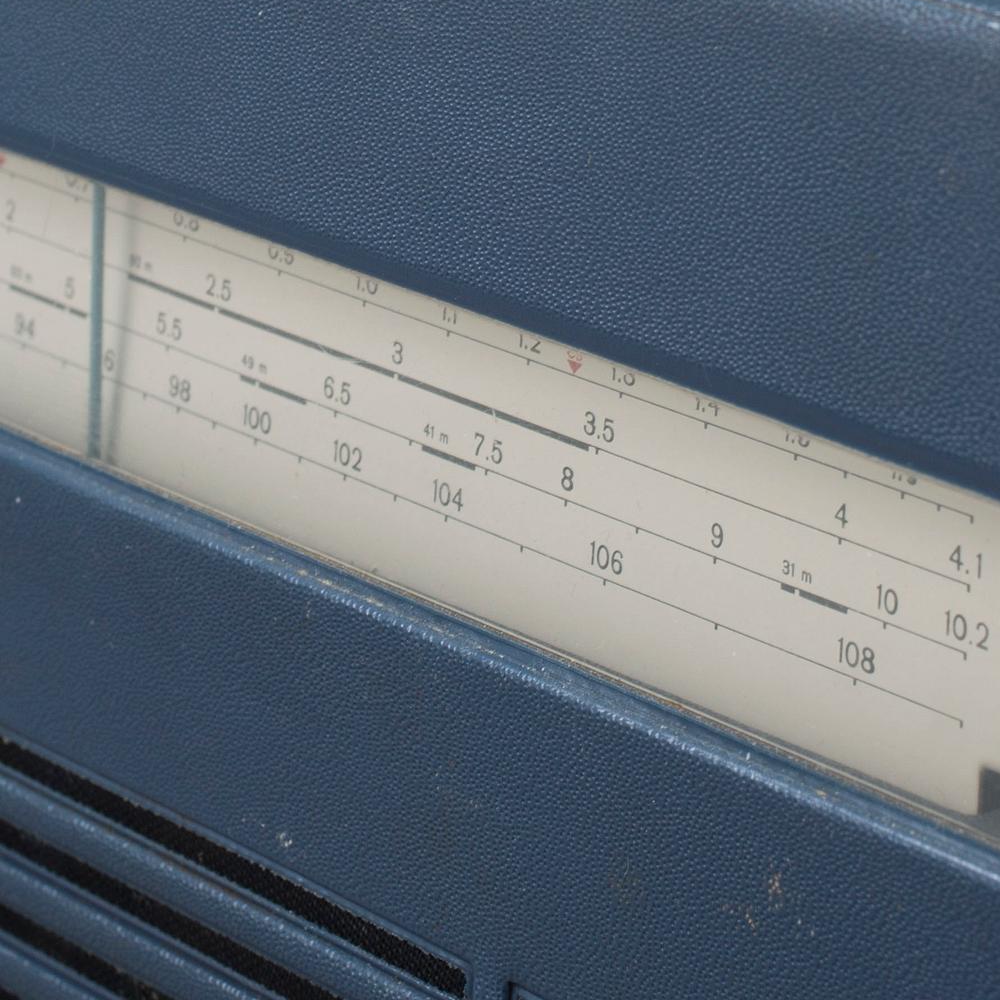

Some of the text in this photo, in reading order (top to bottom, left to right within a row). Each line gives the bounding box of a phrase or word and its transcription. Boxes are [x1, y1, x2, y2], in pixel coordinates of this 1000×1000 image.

[5, 200, 16, 221] 2
[205, 274, 232, 302] 2.5
[391, 341, 404, 365] 3
[583, 411, 615, 443] 3.5
[834, 503, 849, 528] 4
[949, 546, 984, 579] 4.1
[14, 313, 35, 337] 94
[169, 375, 191, 402] 98
[243, 404, 272, 435] 100
[332, 440, 362, 472] 102
[432, 479, 464, 512] 104
[589, 541, 624, 575] 106
[836, 636, 875, 674] 108
[156, 312, 182, 340] 5.5
[241, 354, 254, 370] 49
[258, 363, 268, 374] m
[323, 376, 351, 406] 6.5
[423, 423, 436, 438] 41
[439, 432, 450, 445] m
[473, 432, 504, 464] 7.5
[561, 467, 574, 492] 8
[711, 523, 725, 548] 9
[782, 561, 796, 578] 31
[801, 570, 813, 584] m
[876, 584, 899, 615] 10
[943, 610, 990, 651] 10.2
